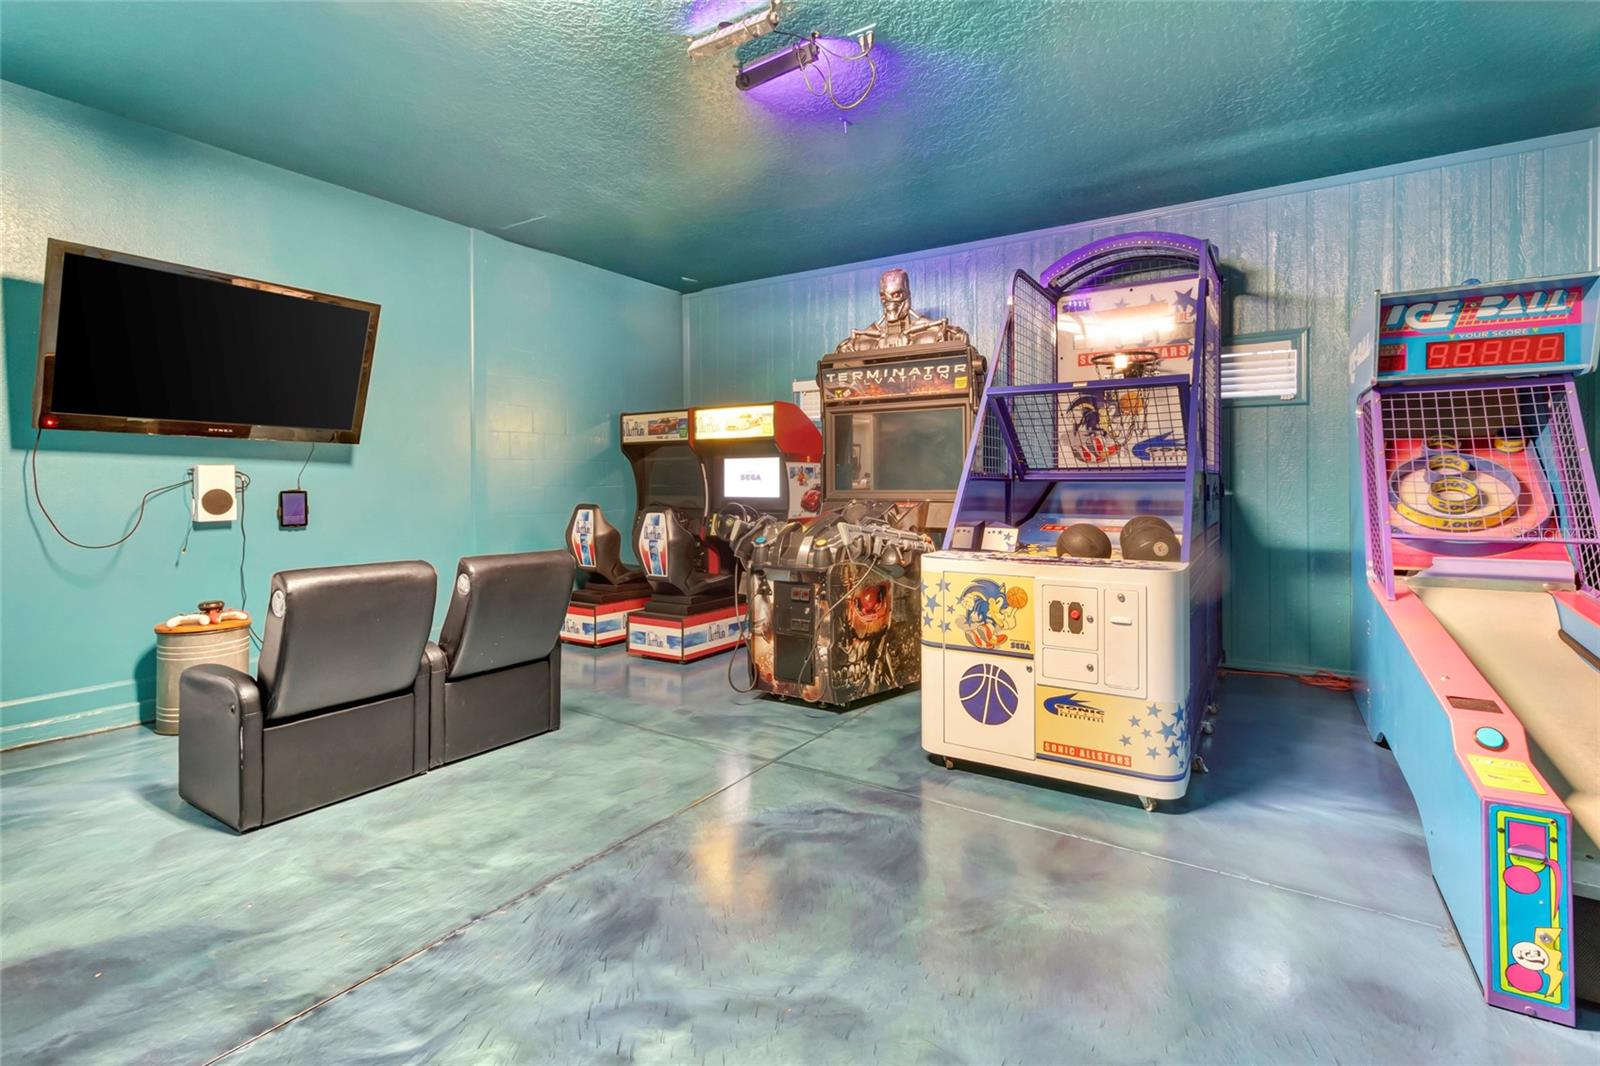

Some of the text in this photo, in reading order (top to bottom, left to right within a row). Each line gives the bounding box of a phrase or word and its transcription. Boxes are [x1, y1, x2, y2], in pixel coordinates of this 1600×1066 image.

[1386, 289, 1570, 331] ICE BALL
[1459, 329, 1529, 339] YOUR SCORE
[826, 364, 967, 382] TERMINATOR
[838, 374, 949, 387] SALVATION
[740, 473, 762, 481] SEGA
[1010, 641, 1031, 651] SEGA
[1055, 704, 1104, 716] SONIC
[1044, 741, 1131, 766] SONIC ALLSTARS
